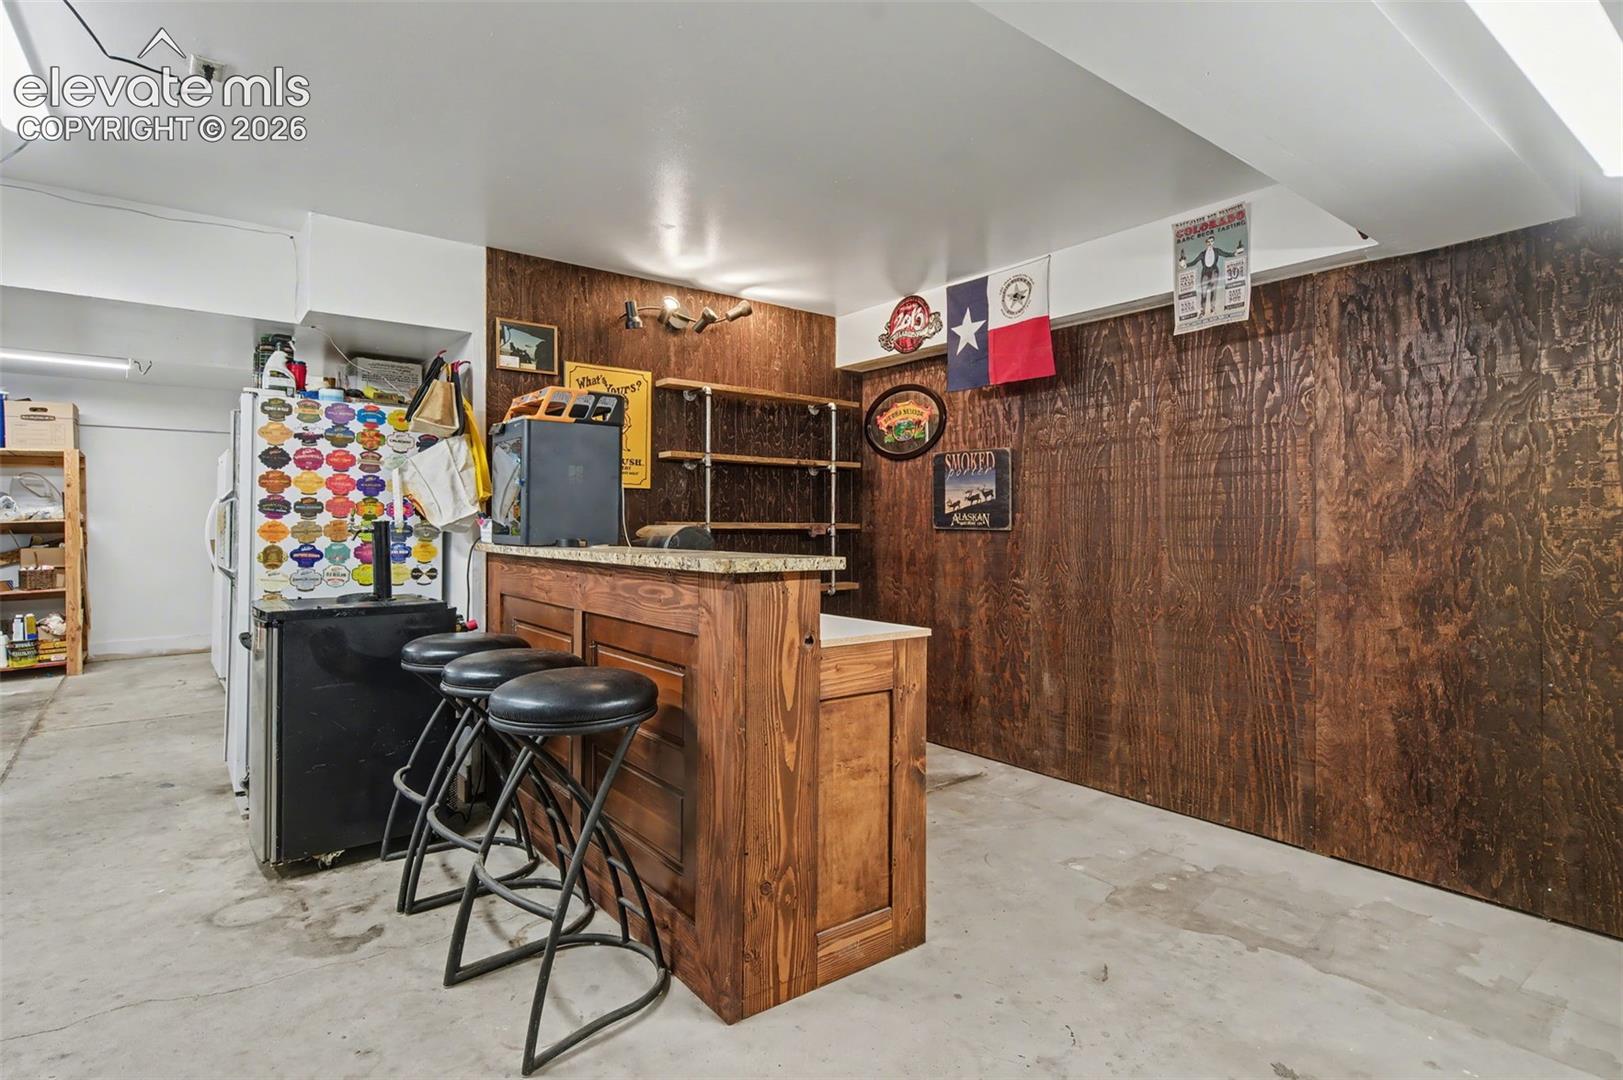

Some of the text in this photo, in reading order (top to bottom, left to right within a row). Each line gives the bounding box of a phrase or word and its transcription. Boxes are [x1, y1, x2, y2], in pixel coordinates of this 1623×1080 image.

[1175, 209, 1246, 238] COLORADO
[576, 374, 607, 389] What's
[621, 457, 642, 466] USH
[945, 451, 996, 470] SMOKED
[950, 512, 991, 528] ALASKAN
